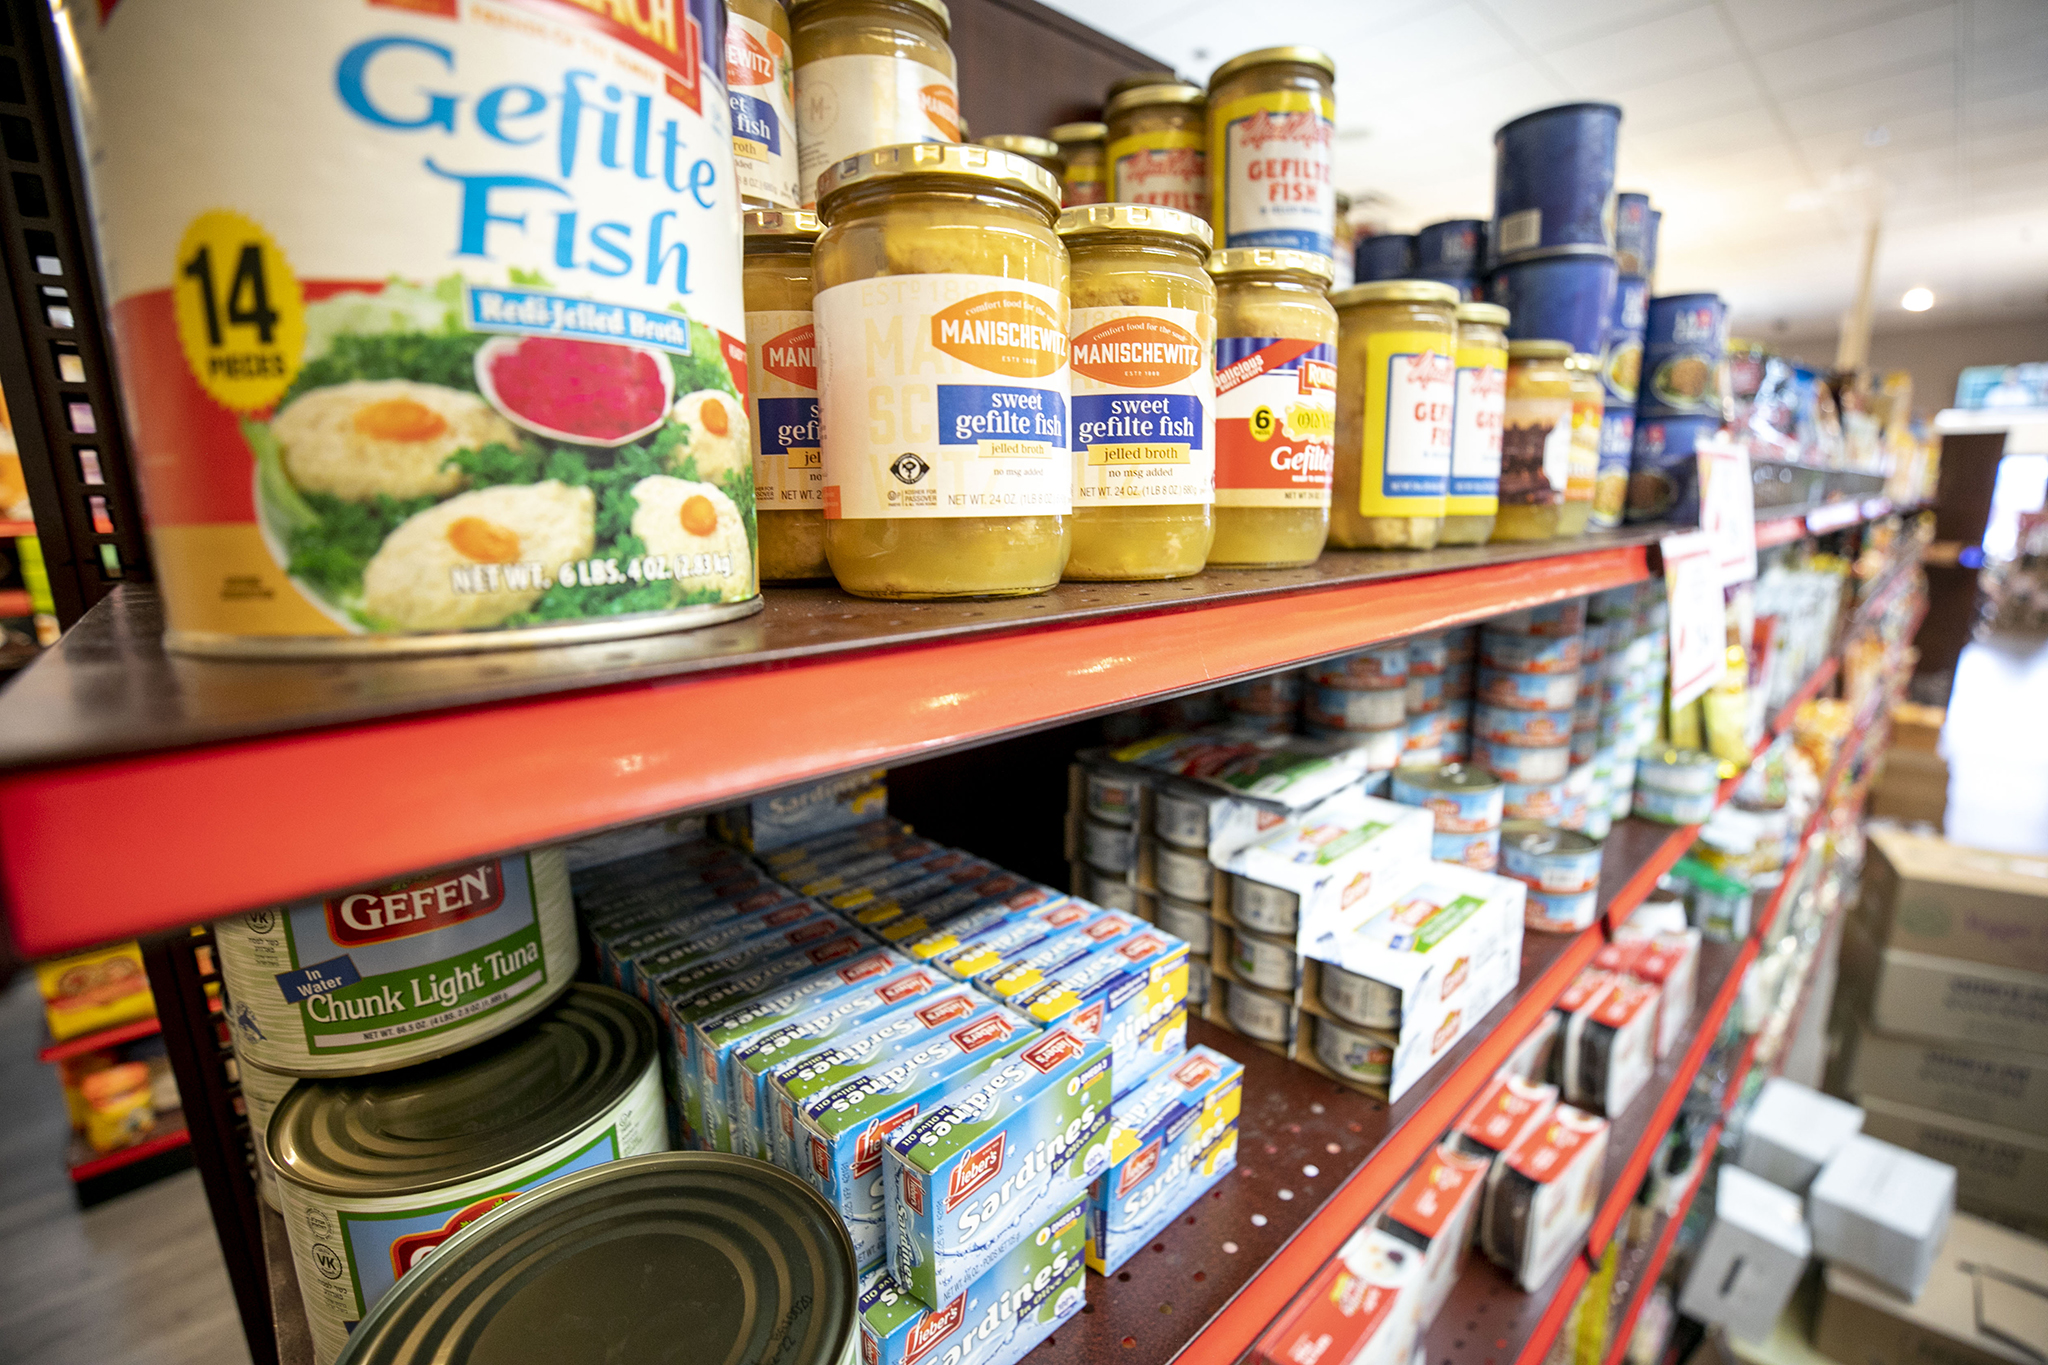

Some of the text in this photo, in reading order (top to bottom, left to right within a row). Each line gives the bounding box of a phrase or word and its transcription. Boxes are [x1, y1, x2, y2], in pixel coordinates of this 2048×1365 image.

[726, 45, 772, 78] EWITZ
[333, 34, 717, 210] Gefilte
[736, 114, 772, 140] fish
[732, 142, 757, 155] roth
[1247, 158, 1331, 185] GEFILTE
[1268, 181, 1318, 203] FISH
[421, 156, 696, 296] Fish
[178, 241, 283, 349] 14
[964, 300, 1002, 317] comfort
[1002, 299, 1022, 309] food
[1023, 301, 1035, 312] for
[628, 309, 685, 346] Broth
[940, 318, 1067, 358] MANISCHEWITZ
[1093, 322, 1171, 342] comfort food for the
[206, 354, 286, 381] PIECES
[768, 346, 818, 368] MANI
[1073, 342, 1200, 367] MANISCHEWITZ
[991, 391, 1043, 411] sweet
[1111, 397, 1171, 415] sweet
[955, 410, 1063, 440] gefilte fish
[1079, 416, 1195, 444] gefilte fish
[1255, 409, 1271, 430] 6
[990, 442, 1045, 456] jelled broth
[1104, 447, 1178, 462] jelled broth
[1270, 444, 1334, 476] Gefilte
[993, 468, 1044, 478] no msg added
[1108, 467, 1173, 479] no msg added
[781, 489, 815, 501] NET WT.
[948, 494, 967, 505] NET
[970, 494, 988, 505] WT.
[989, 494, 1001, 506] 24
[1080, 487, 1096, 498] NET
[1097, 486, 1112, 497] WT.
[1114, 486, 1125, 497] 24
[1126, 485, 1140, 497] OZ.
[450, 562, 500, 594] NET
[502, 562, 551, 592] WT.
[558, 560, 578, 588] 6
[577, 557, 627, 587] LBS.
[627, 555, 642, 583] 4
[642, 555, 673, 582] OZ.
[340, 865, 491, 931] GEFEN
[249, 909, 269, 925] VK
[297, 976, 343, 999] Water
[305, 969, 323, 983] In
[306, 940, 540, 1024] Chunk Light Tuna
[724, 979, 834, 1030] Sardines
[363, 1031, 379, 1041] NET
[380, 1029, 394, 1039] WT.
[759, 996, 873, 1057] Sardines
[962, 1018, 1012, 1045] Lieber's
[1112, 994, 1176, 1053] dines
[797, 1018, 913, 1082] Sardines
[1034, 1031, 1086, 1065] Lieber's
[782, 1069, 798, 1080] Oil
[797, 1055, 823, 1072] Olive
[831, 1082, 857, 1102] Olive
[832, 1043, 949, 1114] Sardines
[814, 1099, 831, 1112] Oil
[919, 1064, 1026, 1148] Sardines
[901, 1106, 951, 1147] In Olive Oil
[1052, 1114, 1107, 1172] In Olive Oil
[942, 1148, 998, 1207] Lieber's
[957, 1103, 1096, 1245] Sardines
[1123, 1117, 1226, 1224] Sardines
[896, 1201, 914, 1291] Sardines
[316, 1251, 337, 1271] VK
[943, 1285, 955, 1302] NET
[954, 1278, 964, 1292] WT
[1018, 1259, 1081, 1318] In Olive Oil
[899, 1306, 959, 1365] Lieber's
